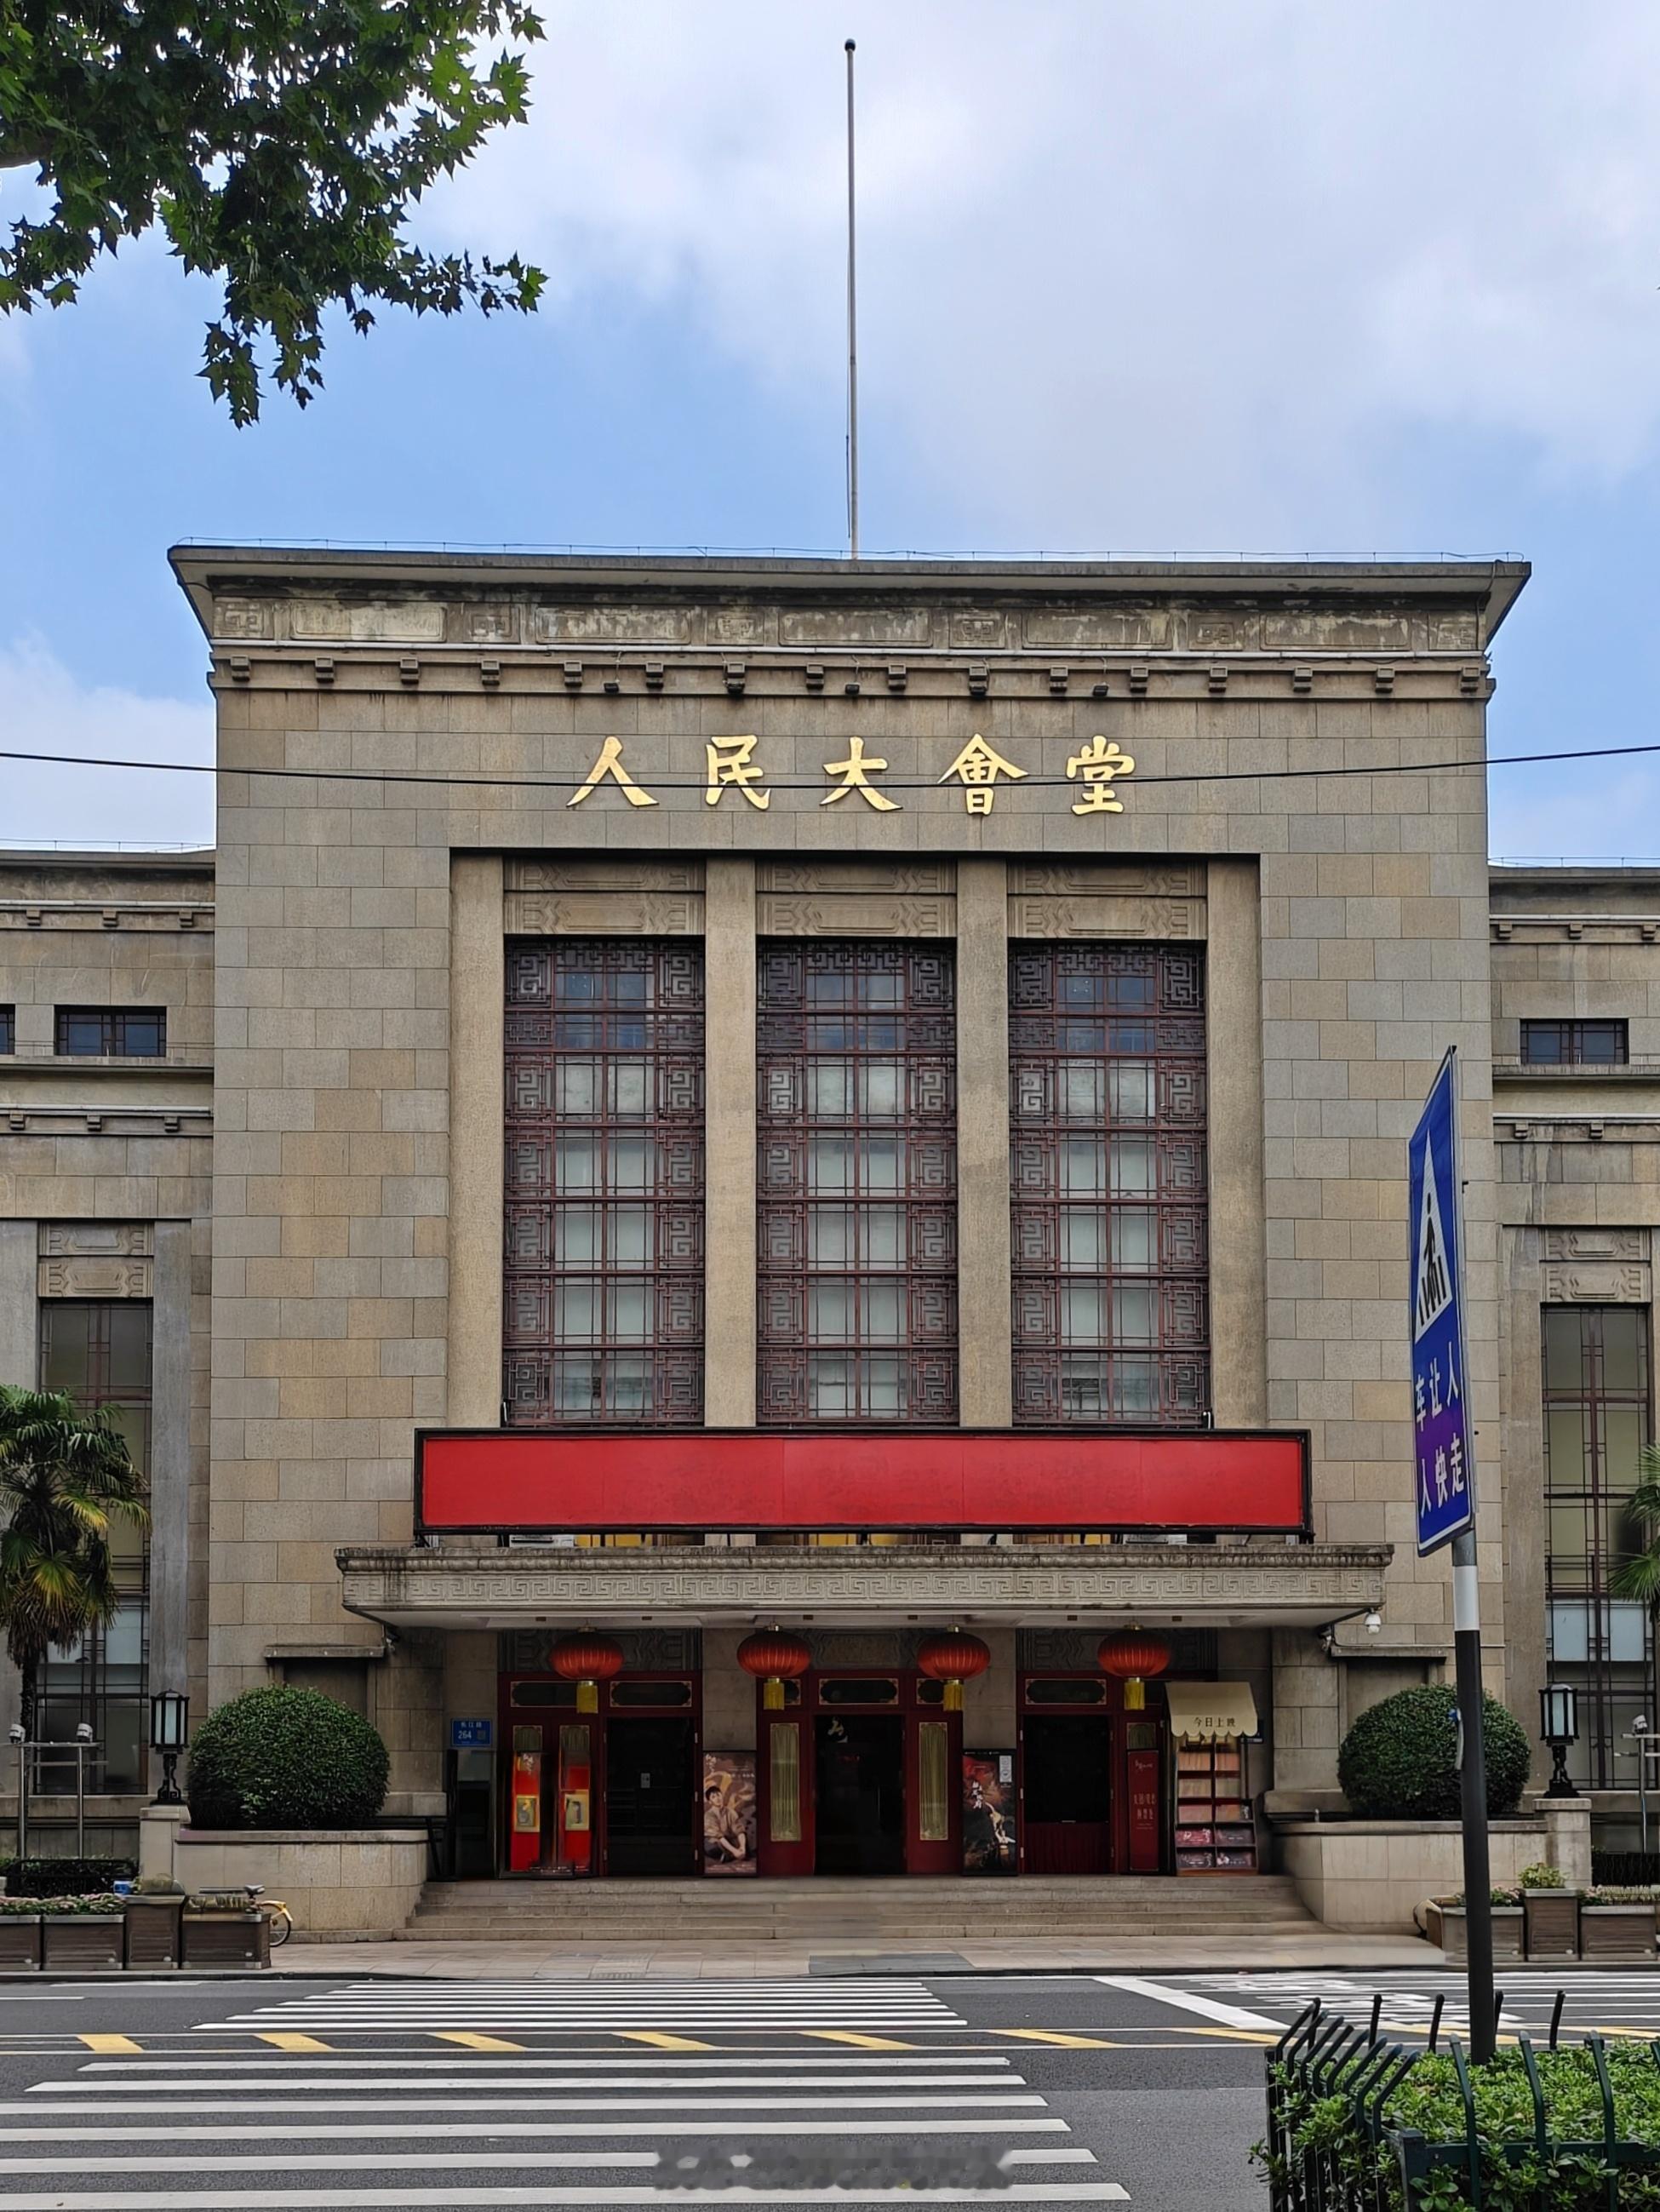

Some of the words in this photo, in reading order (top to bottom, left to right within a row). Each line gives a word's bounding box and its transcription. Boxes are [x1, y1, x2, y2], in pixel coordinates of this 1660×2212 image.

[566, 733, 1136, 816] 人民大會堂
[1415, 1341, 1459, 1432] 车让人
[1420, 1432, 1464, 1519] 人快走
[457, 1729, 472, 1740] 264
[1193, 1716, 1236, 1728] 今日上映
